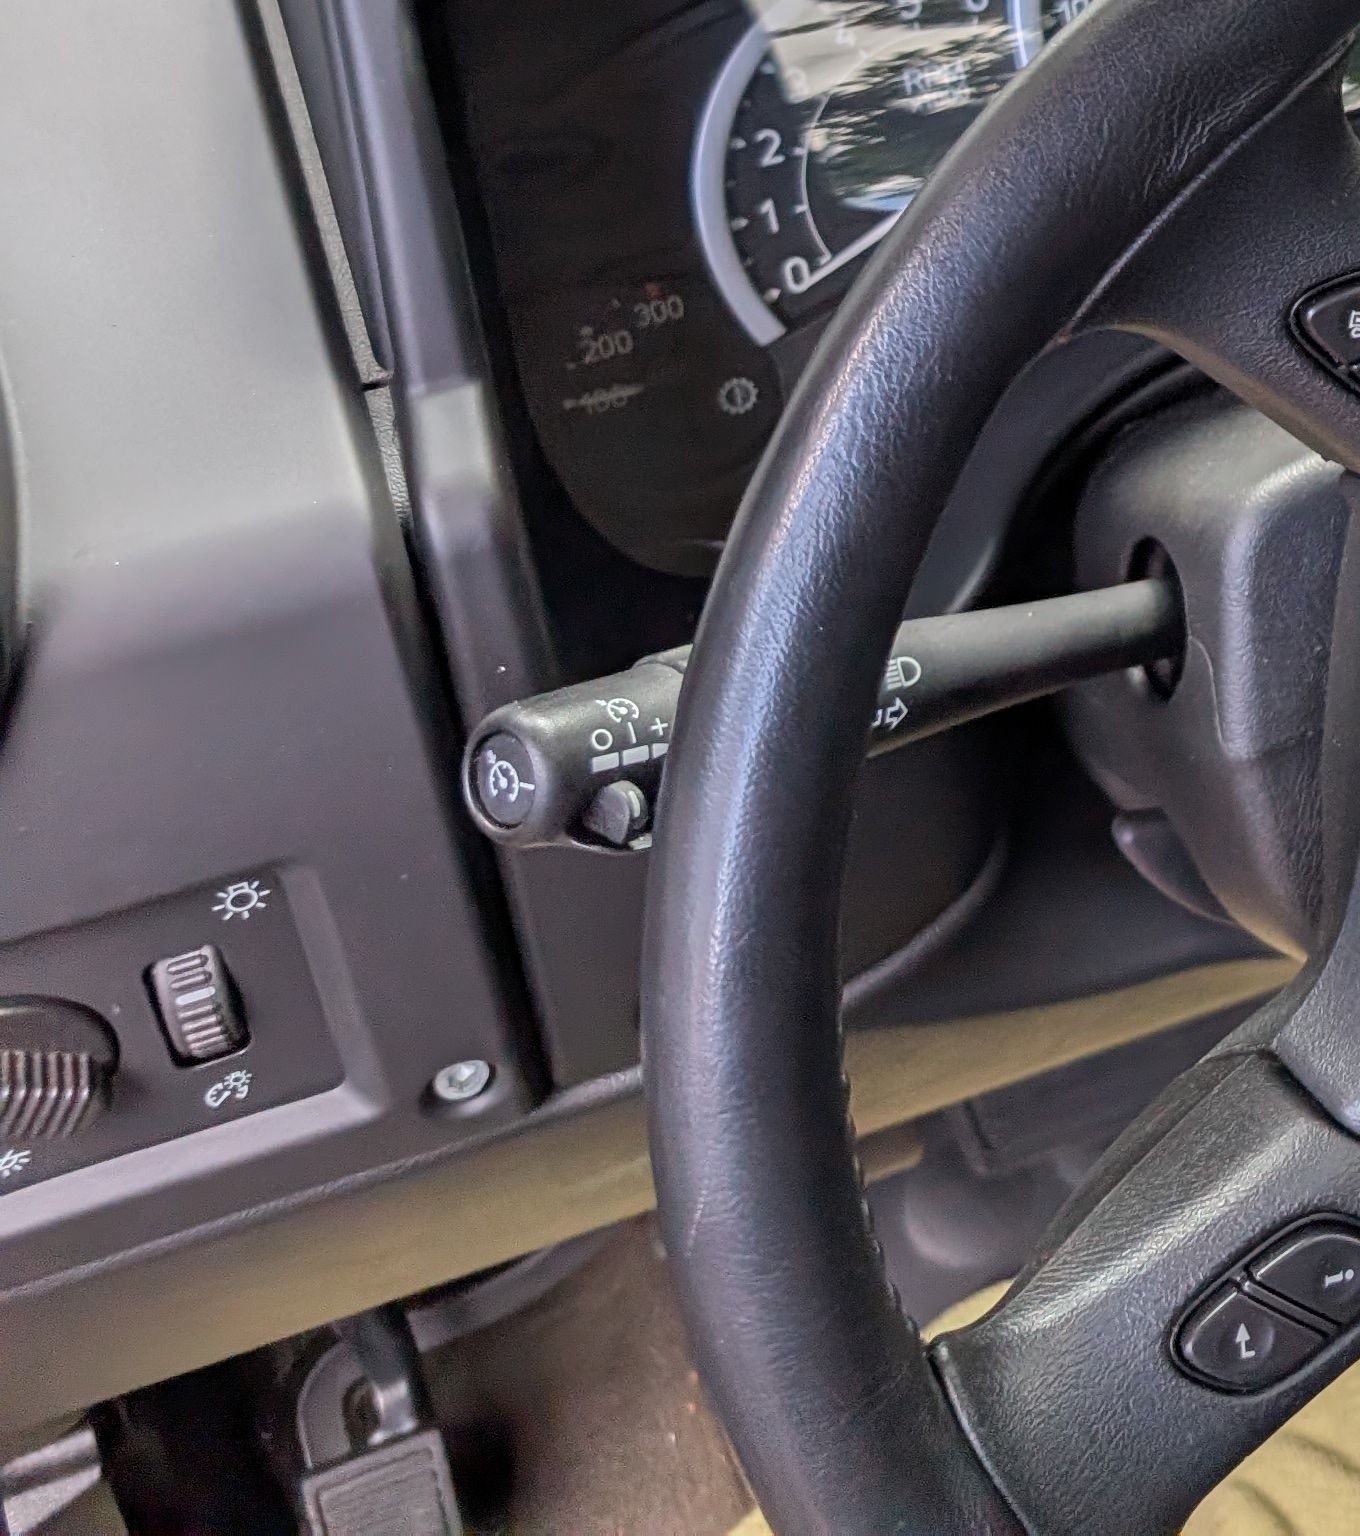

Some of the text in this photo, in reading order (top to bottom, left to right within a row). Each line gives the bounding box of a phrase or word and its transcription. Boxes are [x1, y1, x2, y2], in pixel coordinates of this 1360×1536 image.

[754, 128, 786, 167] 2
[759, 197, 780, 235] 1
[783, 256, 811, 295] 0
[633, 294, 685, 328] 300
